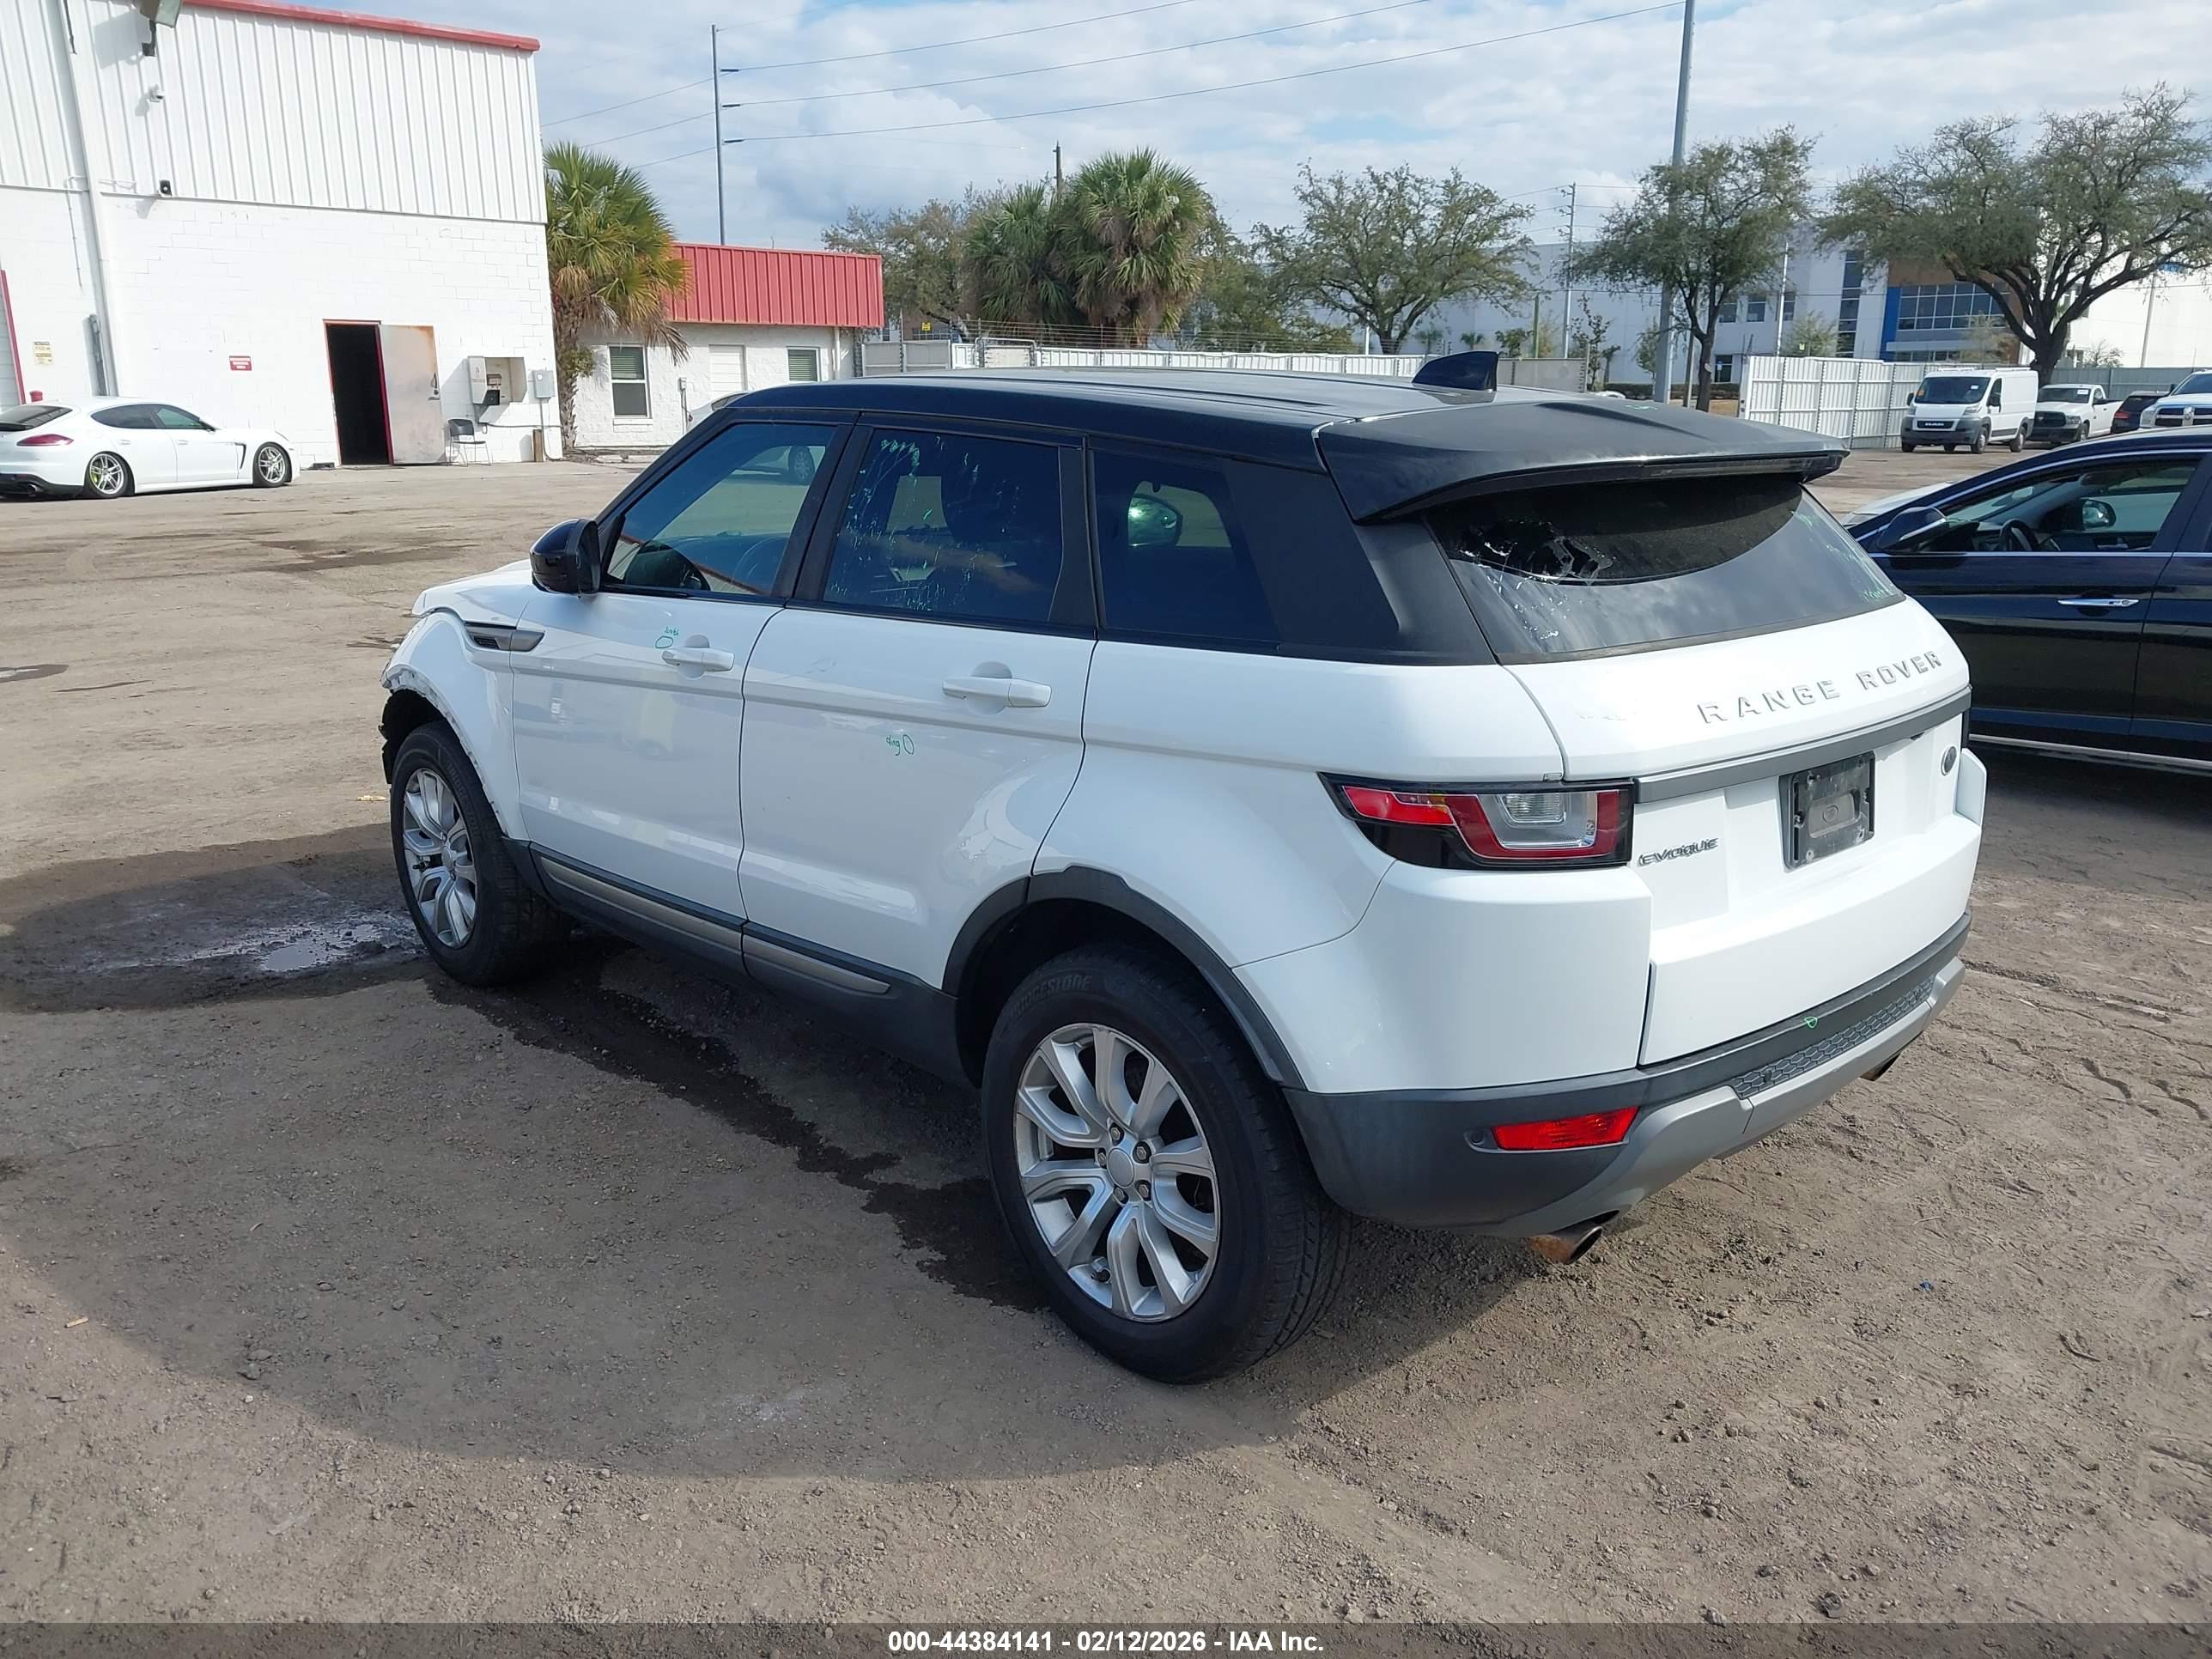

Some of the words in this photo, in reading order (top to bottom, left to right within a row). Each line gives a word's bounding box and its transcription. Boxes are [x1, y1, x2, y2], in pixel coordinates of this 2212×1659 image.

[1697, 680, 1840, 724] RANGE
[1856, 650, 1942, 690] ROVER
[1638, 837, 1719, 867] EVOQUE
